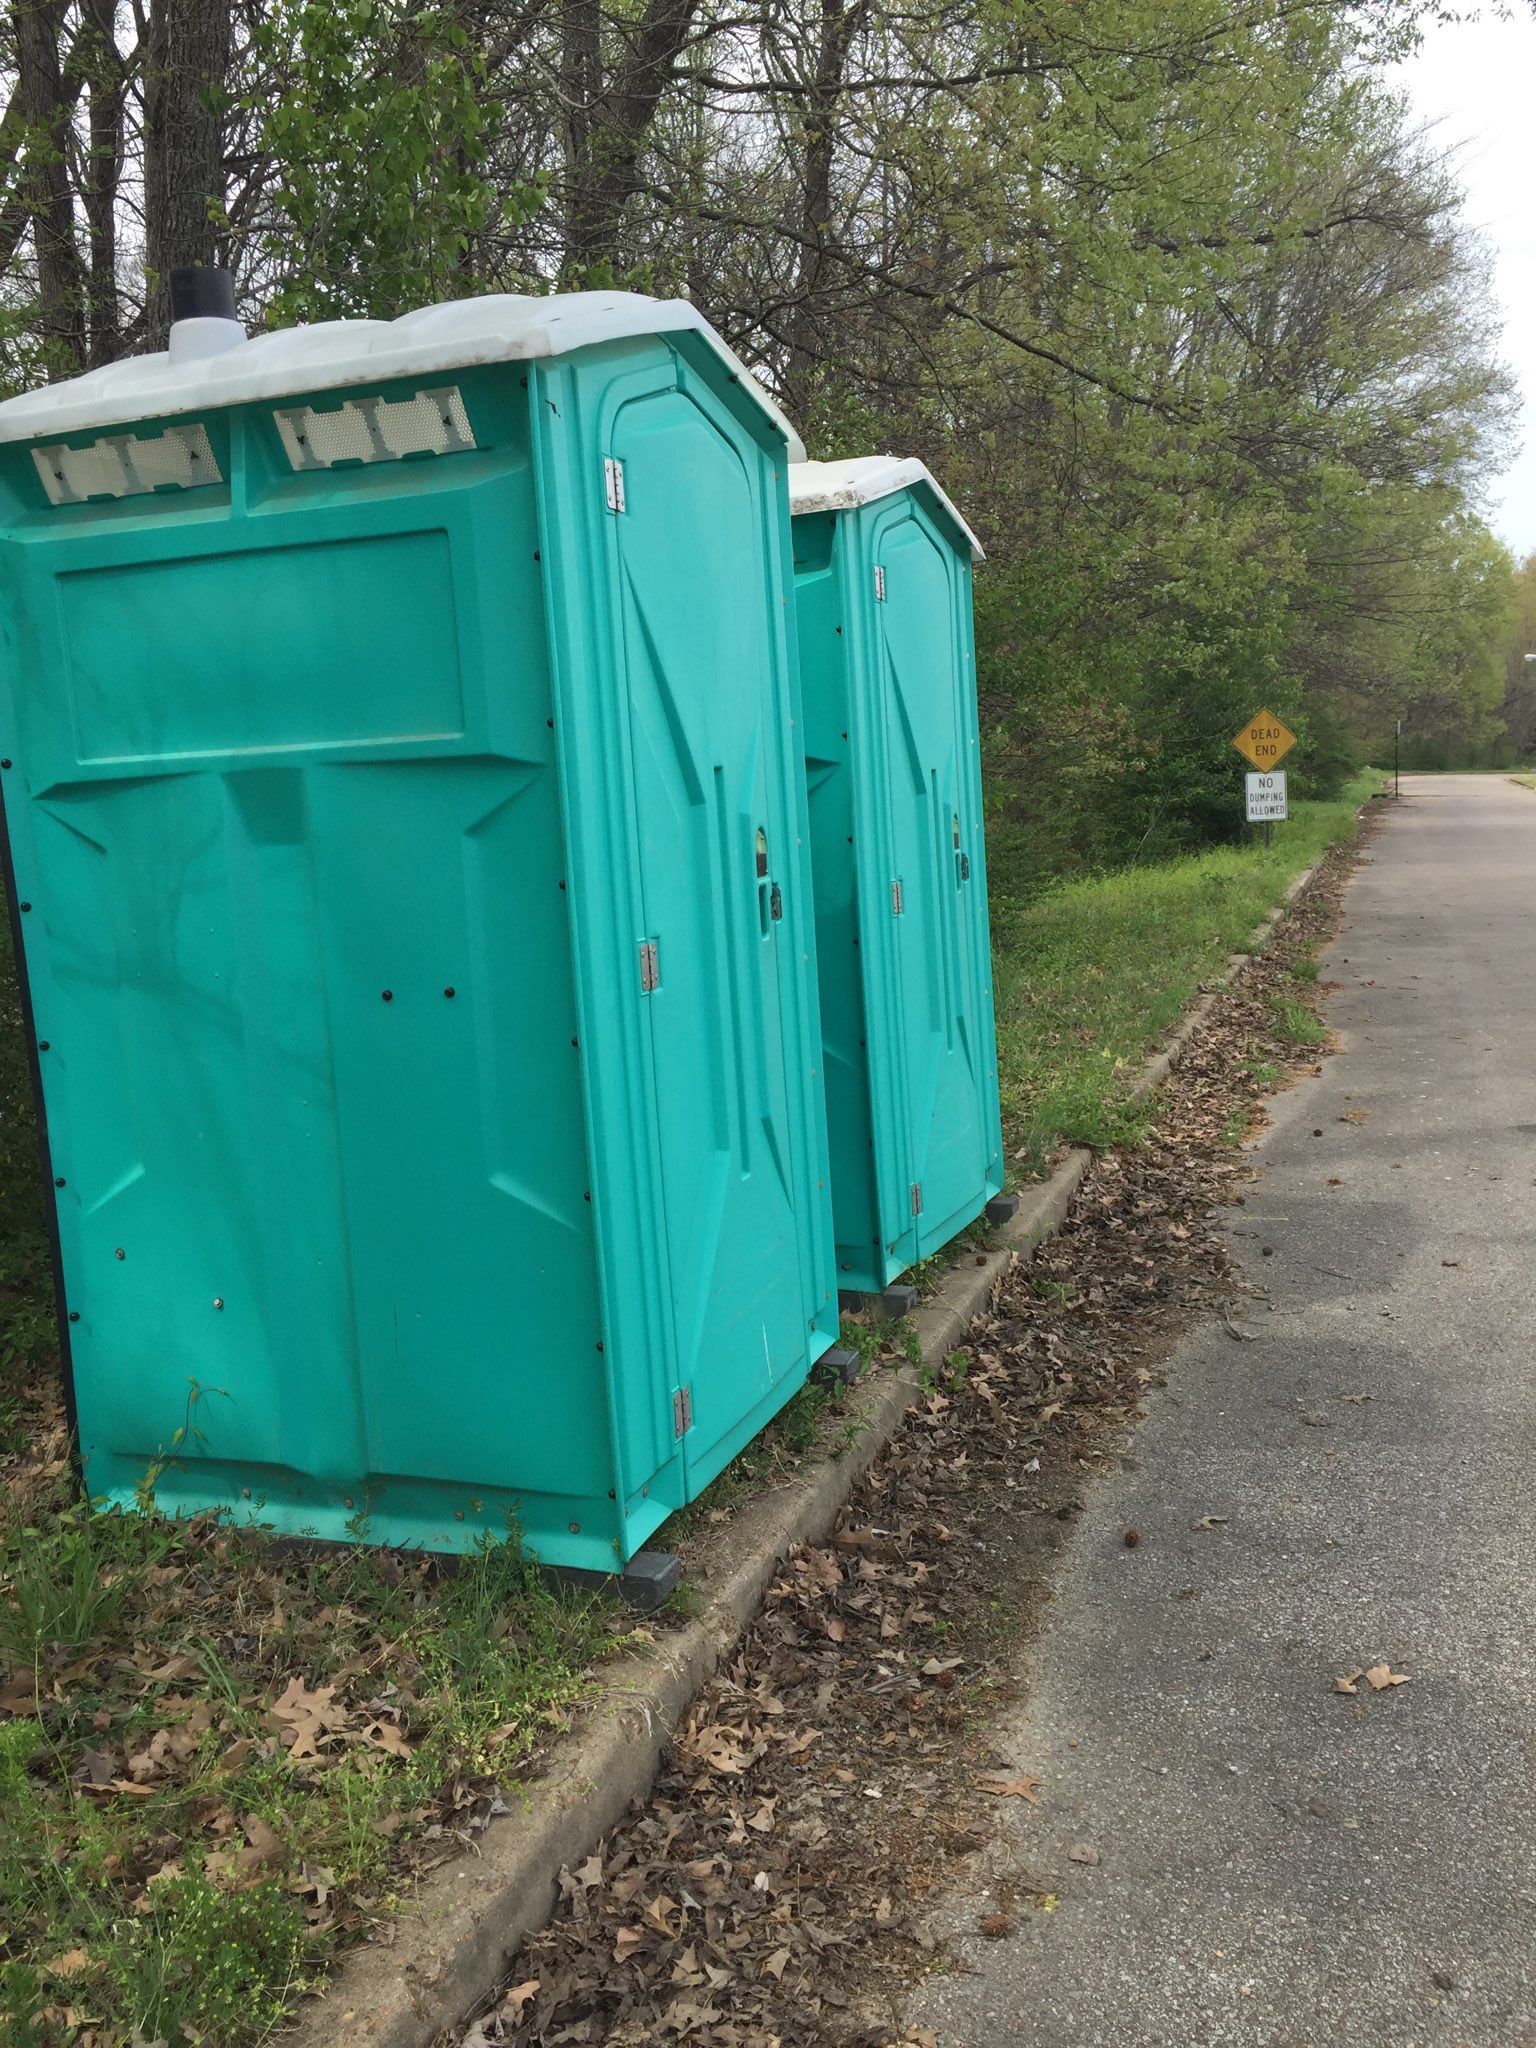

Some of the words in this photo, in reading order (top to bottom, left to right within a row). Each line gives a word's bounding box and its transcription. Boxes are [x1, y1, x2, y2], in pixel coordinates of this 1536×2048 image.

[1251, 728, 1280, 740] DEAD
[1255, 745, 1277, 756] END
[1258, 777, 1274, 788] NO
[1249, 792, 1284, 802] DUMPING
[1250, 805, 1285, 815] ALLOWED
